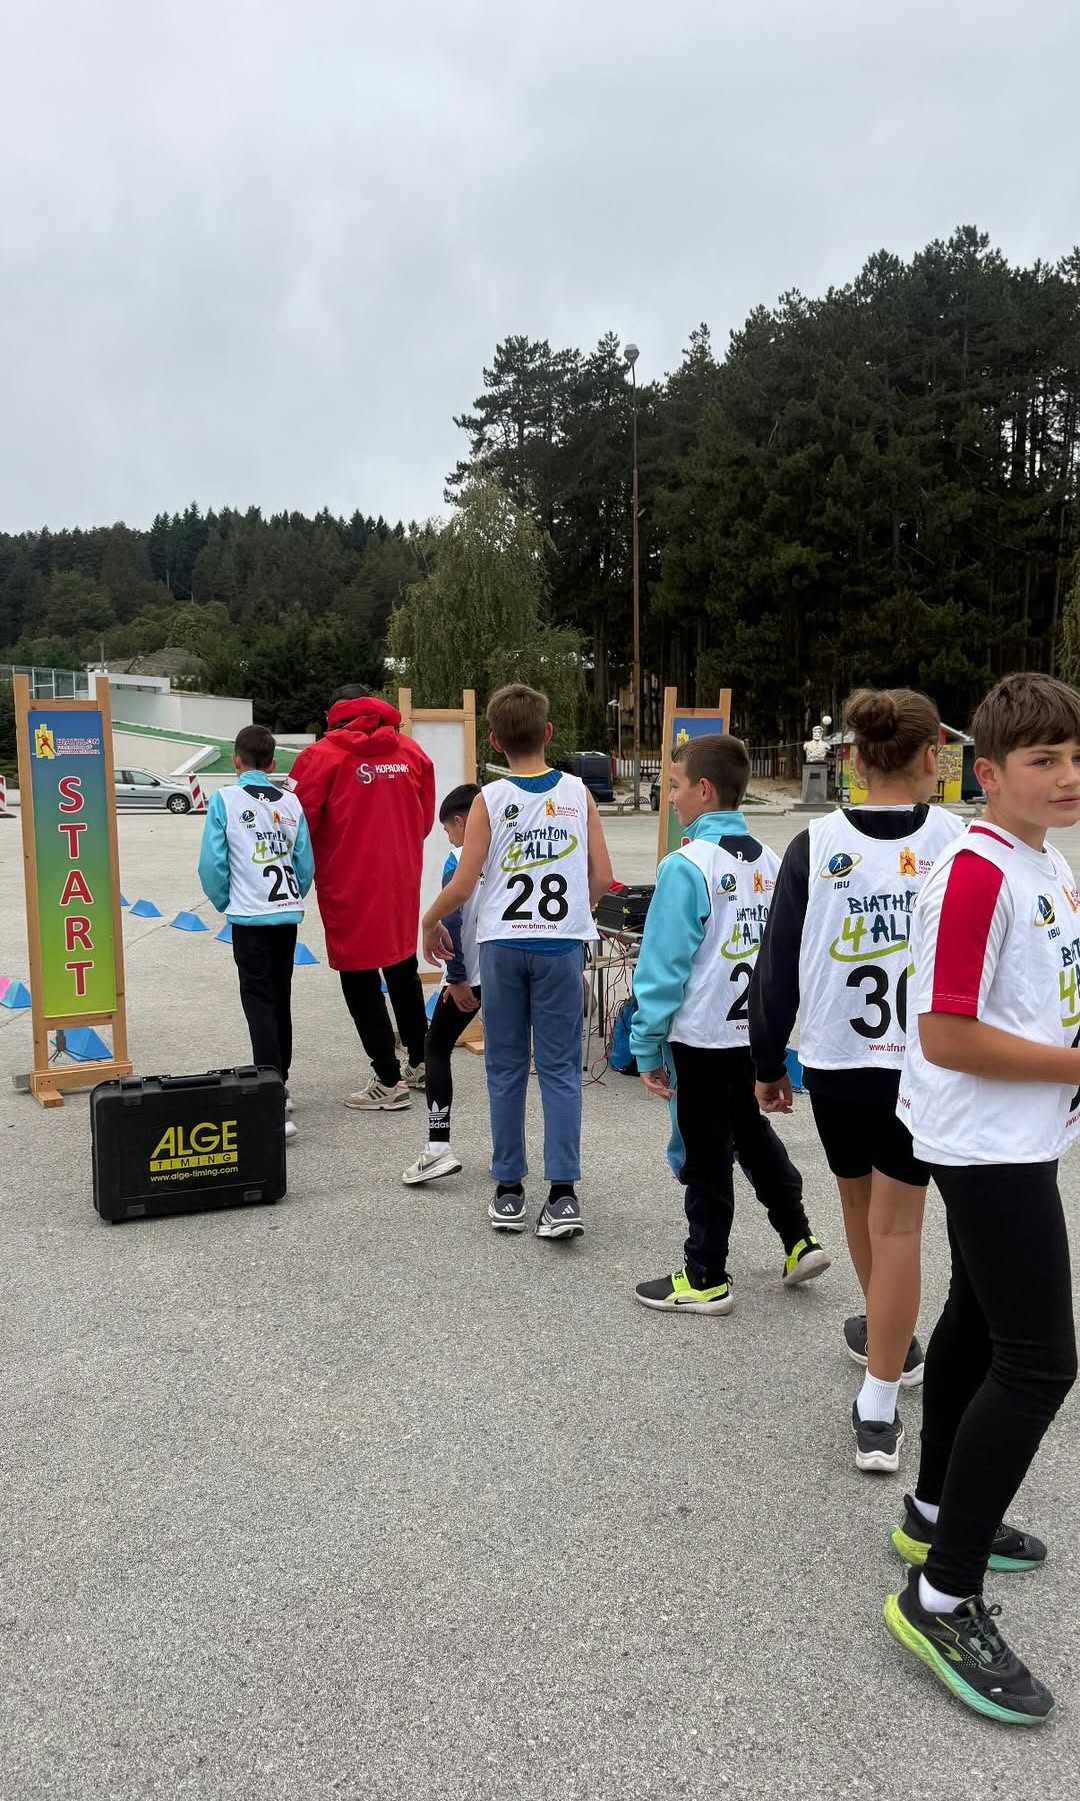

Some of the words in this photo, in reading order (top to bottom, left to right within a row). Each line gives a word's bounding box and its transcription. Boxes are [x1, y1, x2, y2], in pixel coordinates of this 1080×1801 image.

[525, 841, 559, 860] ALL
[58, 776, 94, 997] START
[262, 865, 300, 902] 26
[501, 873, 568, 922] 28
[833, 880, 850, 890] IBU
[841, 916, 868, 953] 4
[1047, 926, 1061, 940] IBU
[725, 962, 754, 1021] 2
[1059, 967, 1077, 1015] 4
[151, 1120, 238, 1159] ALGE
[150, 1166, 239, 1183] www.alge-timing.com
[157, 1154, 232, 1170] TIMING
